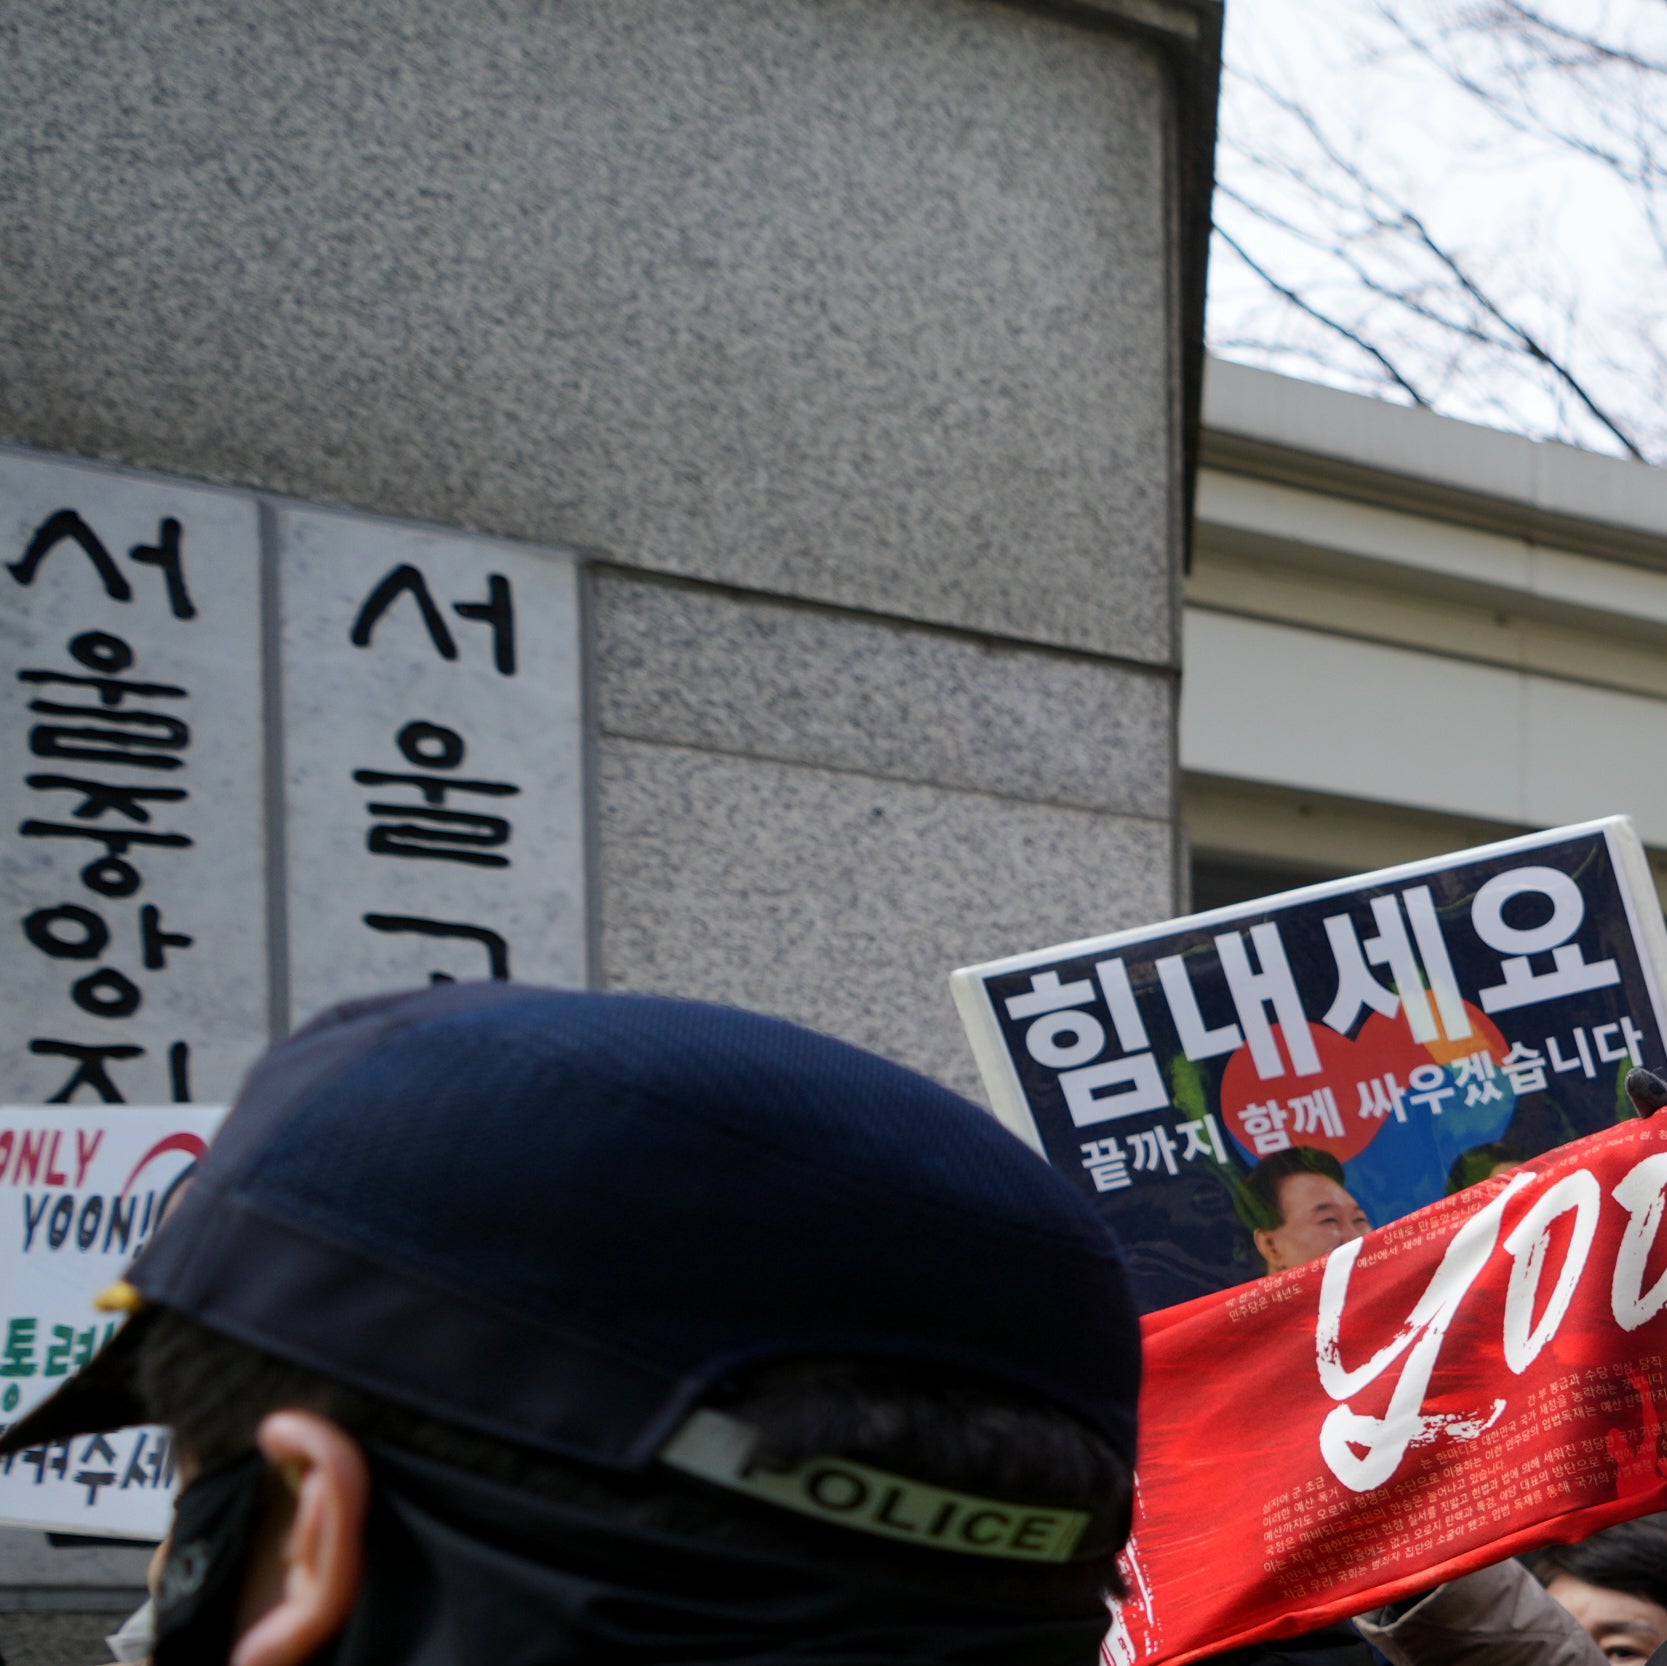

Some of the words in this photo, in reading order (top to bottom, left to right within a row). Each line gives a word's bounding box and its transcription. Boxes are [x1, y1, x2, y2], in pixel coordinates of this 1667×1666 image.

[1005, 866, 1621, 1128] 힘내세요
[1079, 1113, 1229, 1193] 끝까지
[1237, 1091, 1345, 1152] 함께
[1357, 1016, 1646, 1125] 싸우겠습니다
[1229, 1297, 1268, 1322] 민주당은
[1271, 1284, 1301, 1304] 내년도
[1357, 1247, 1398, 1269] 예산에서
[738, 1456, 1058, 1553] POLICE
[1294, 1499, 1314, 1512] 예산
[1435, 1444, 1479, 1465] 한마디로
[1317, 1500, 1351, 1521] 오로지
[1394, 1471, 1440, 1497] 수단으로
[1443, 1457, 1482, 1478] 이용하는
[1319, 1527, 1378, 1554] 대한민국의
[1543, 1444, 1577, 1466] 세워진
